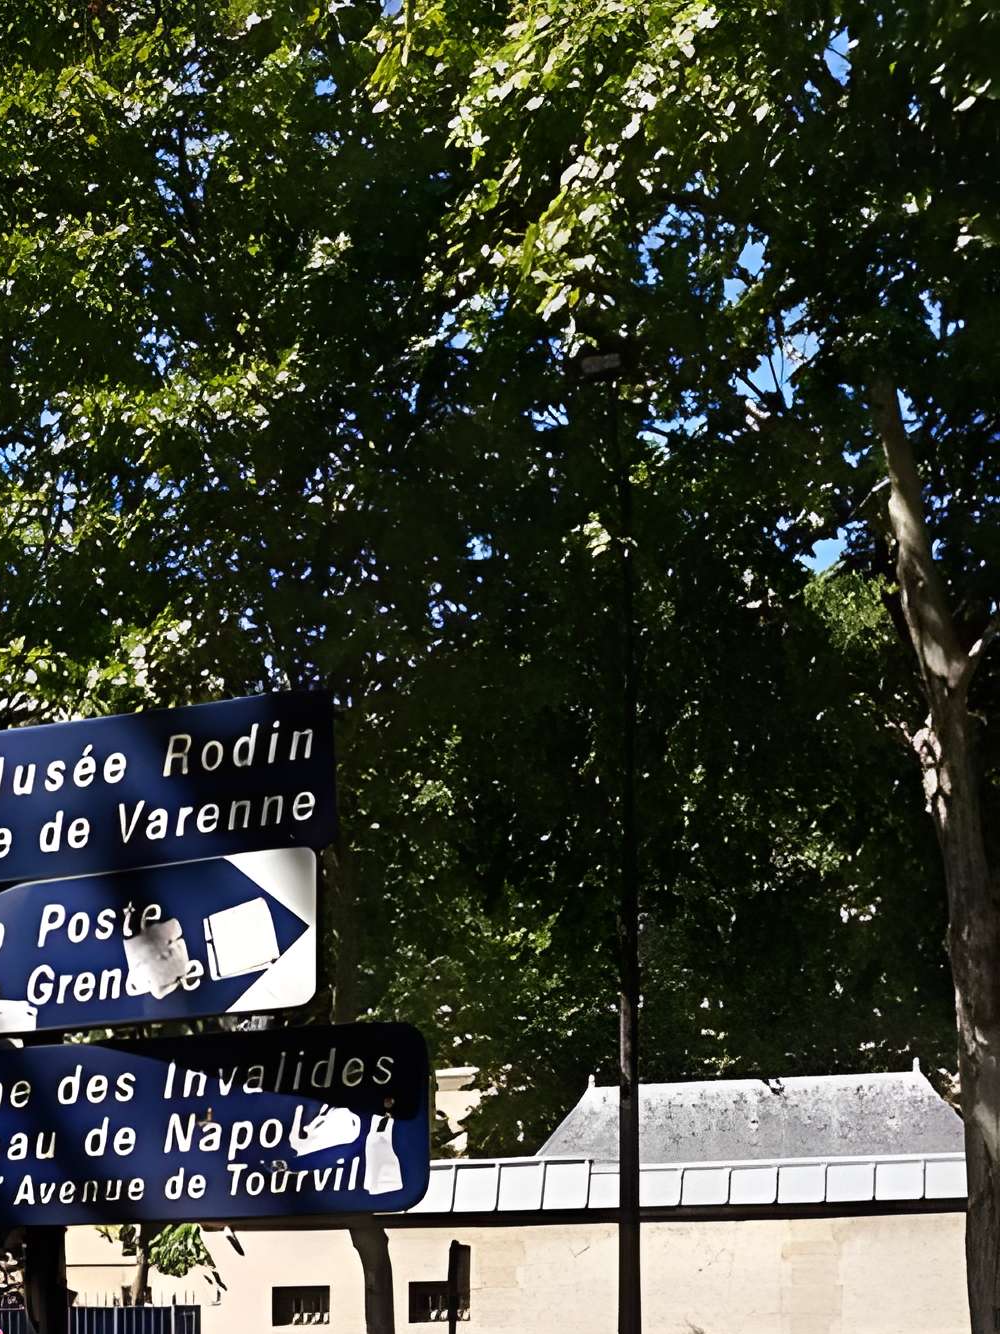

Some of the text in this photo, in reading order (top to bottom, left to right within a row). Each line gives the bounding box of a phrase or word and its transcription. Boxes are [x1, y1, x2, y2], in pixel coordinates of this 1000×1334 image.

[163, 720, 314, 777] Rodin
[38, 810, 90, 853] de
[118, 791, 316, 844] Varenne
[37, 901, 163, 948] Poste
[57, 1064, 137, 1105] des
[163, 1047, 395, 1099] Invalides
[84, 1116, 137, 1156] de
[164, 1167, 207, 1201] de
